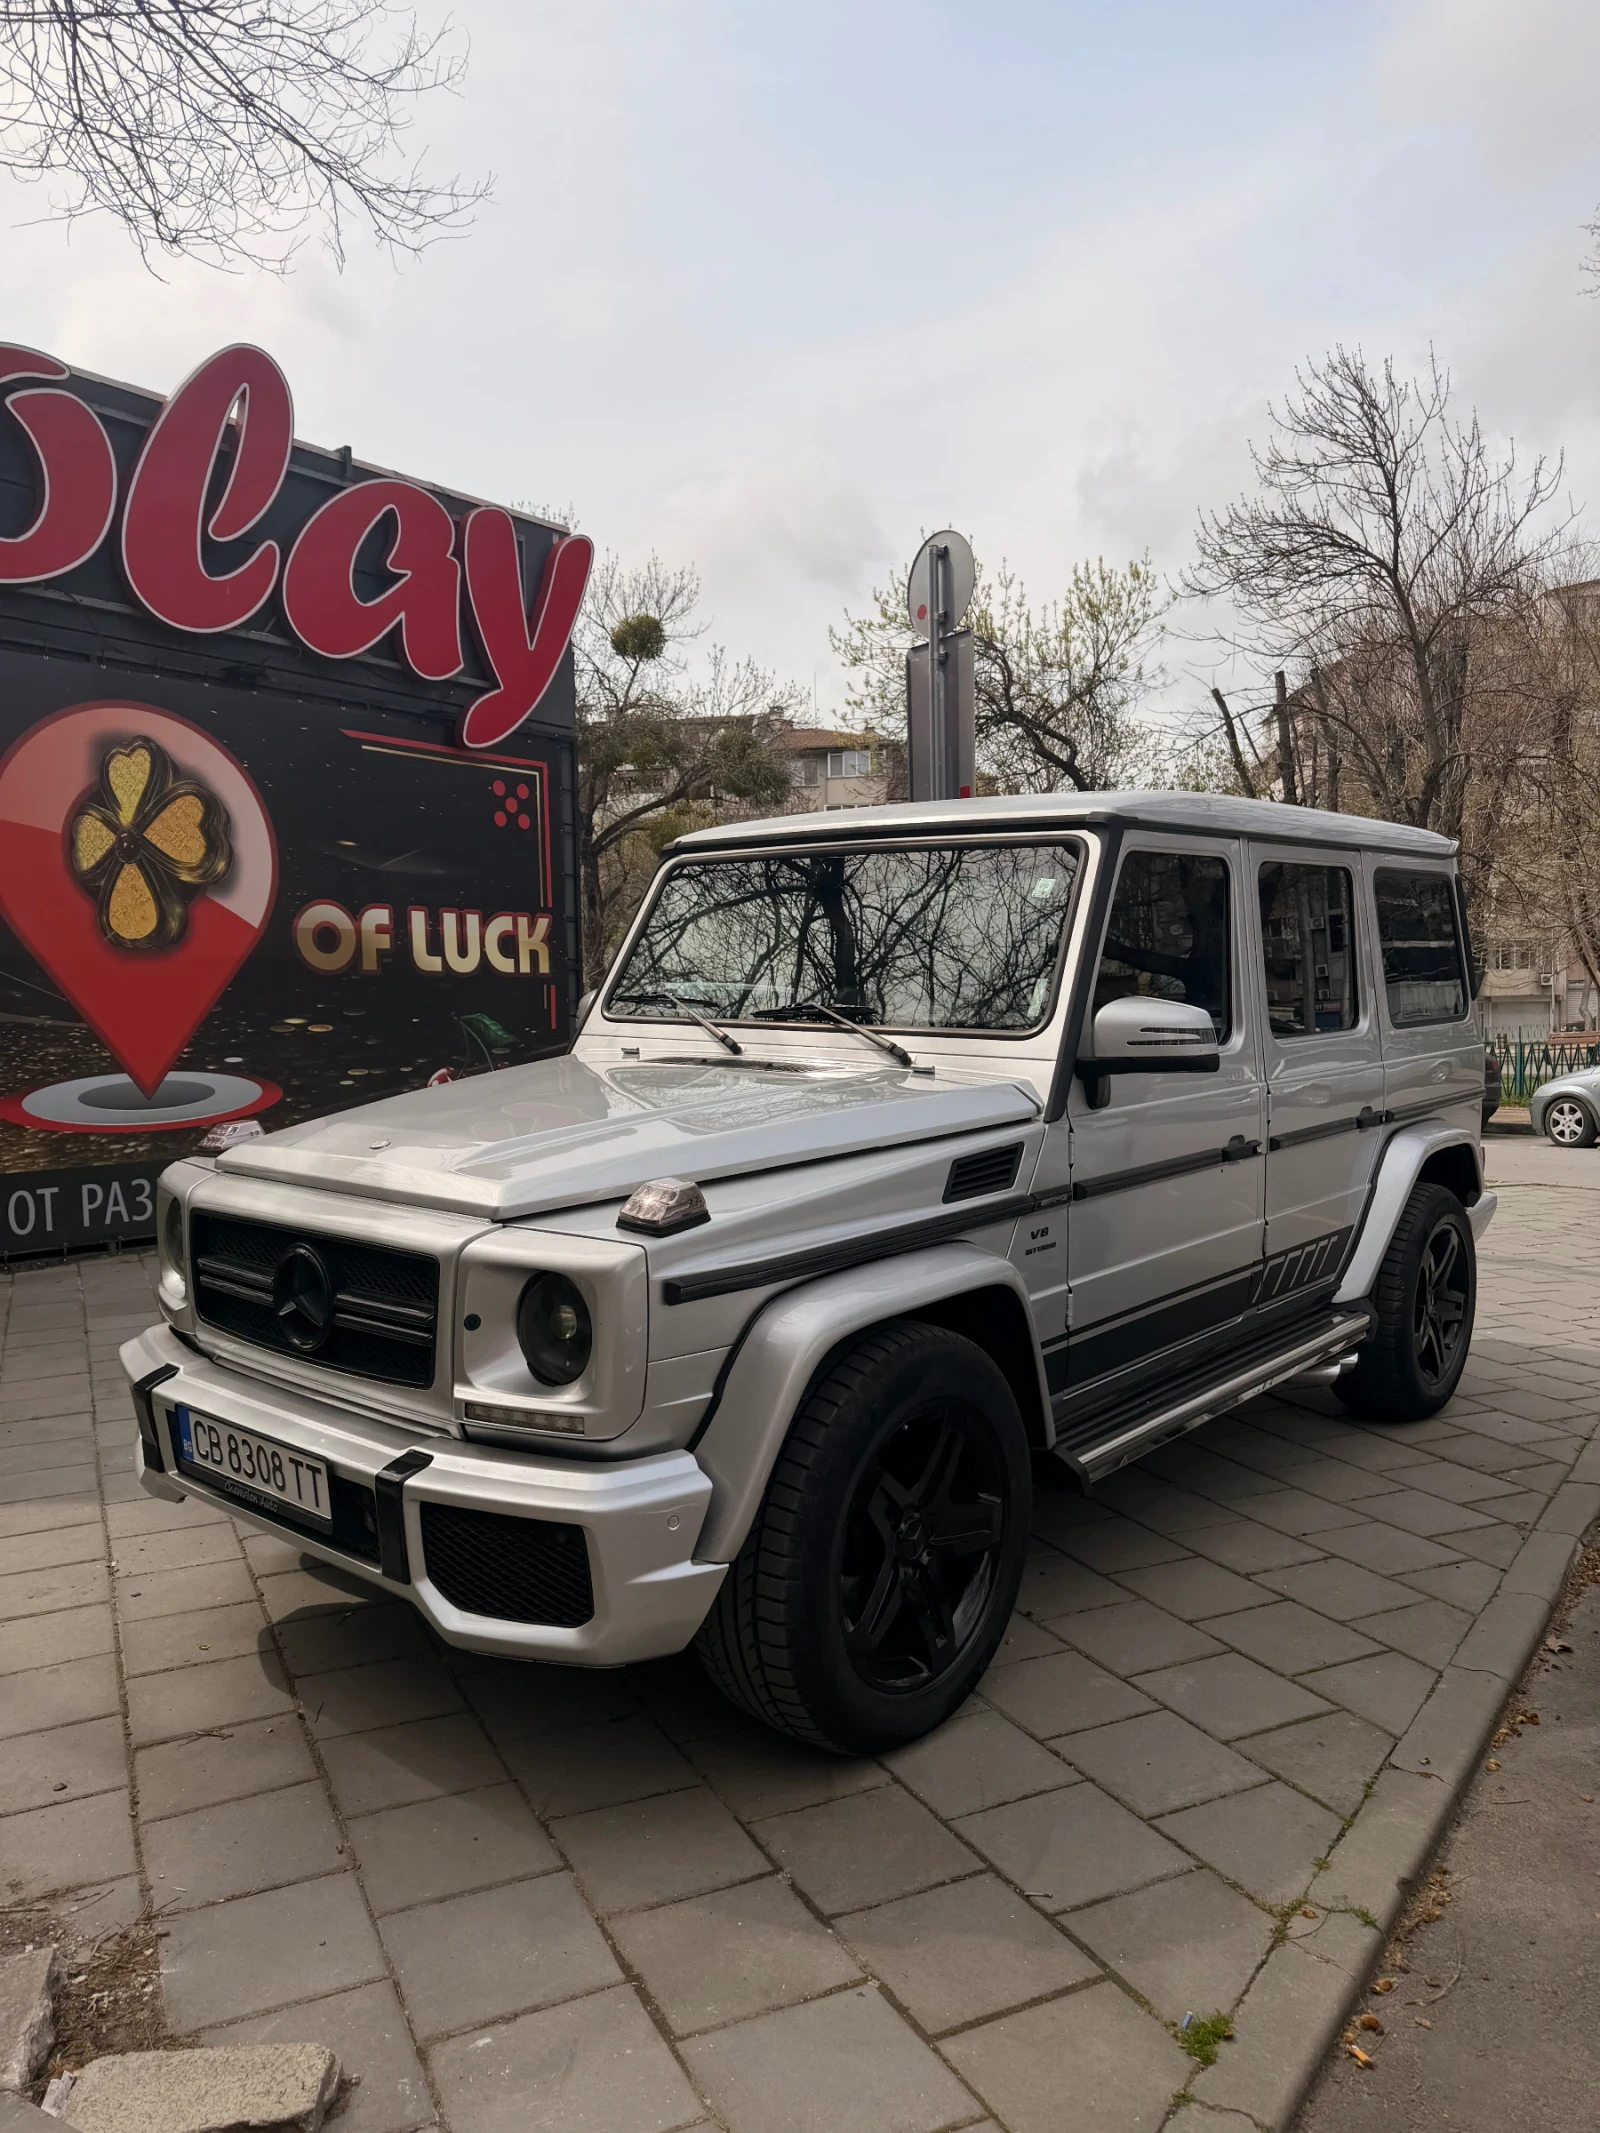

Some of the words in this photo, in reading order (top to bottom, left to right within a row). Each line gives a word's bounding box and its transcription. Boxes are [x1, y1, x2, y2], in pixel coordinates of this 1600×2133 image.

[293, 899, 394, 975] OF
[407, 906, 552, 977] LUCK
[183, 1439, 193, 1453] BG
[194, 1420, 223, 1465] CB
[227, 1433, 286, 1492] 8308
[289, 1456, 322, 1508] TT
